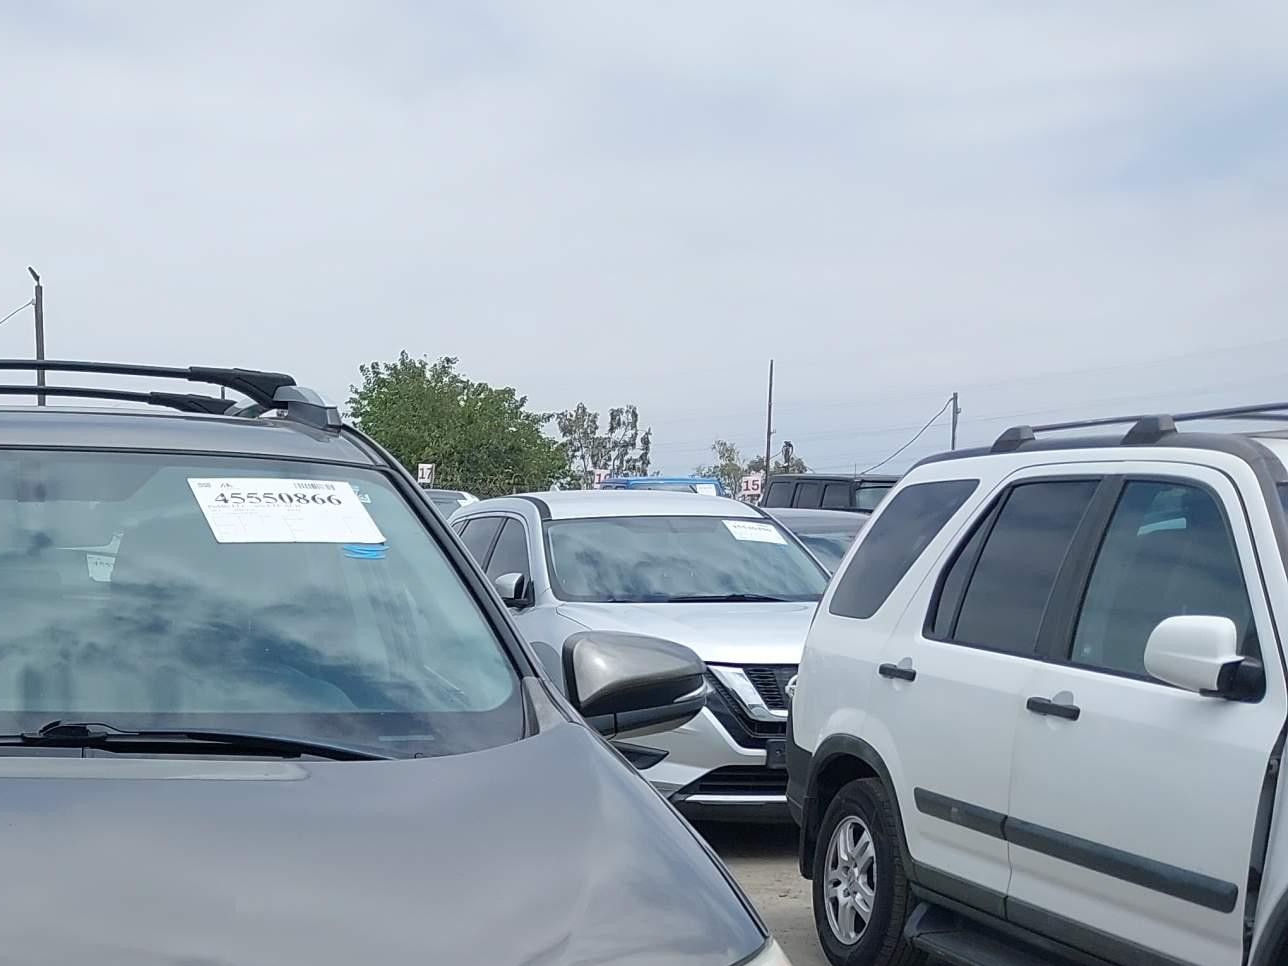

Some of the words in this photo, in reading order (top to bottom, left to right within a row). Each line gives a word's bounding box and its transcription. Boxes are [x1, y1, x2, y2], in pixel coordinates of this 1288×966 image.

[419, 467, 433, 480] 17
[742, 479, 760, 492] 15
[214, 492, 343, 506] 45550866
